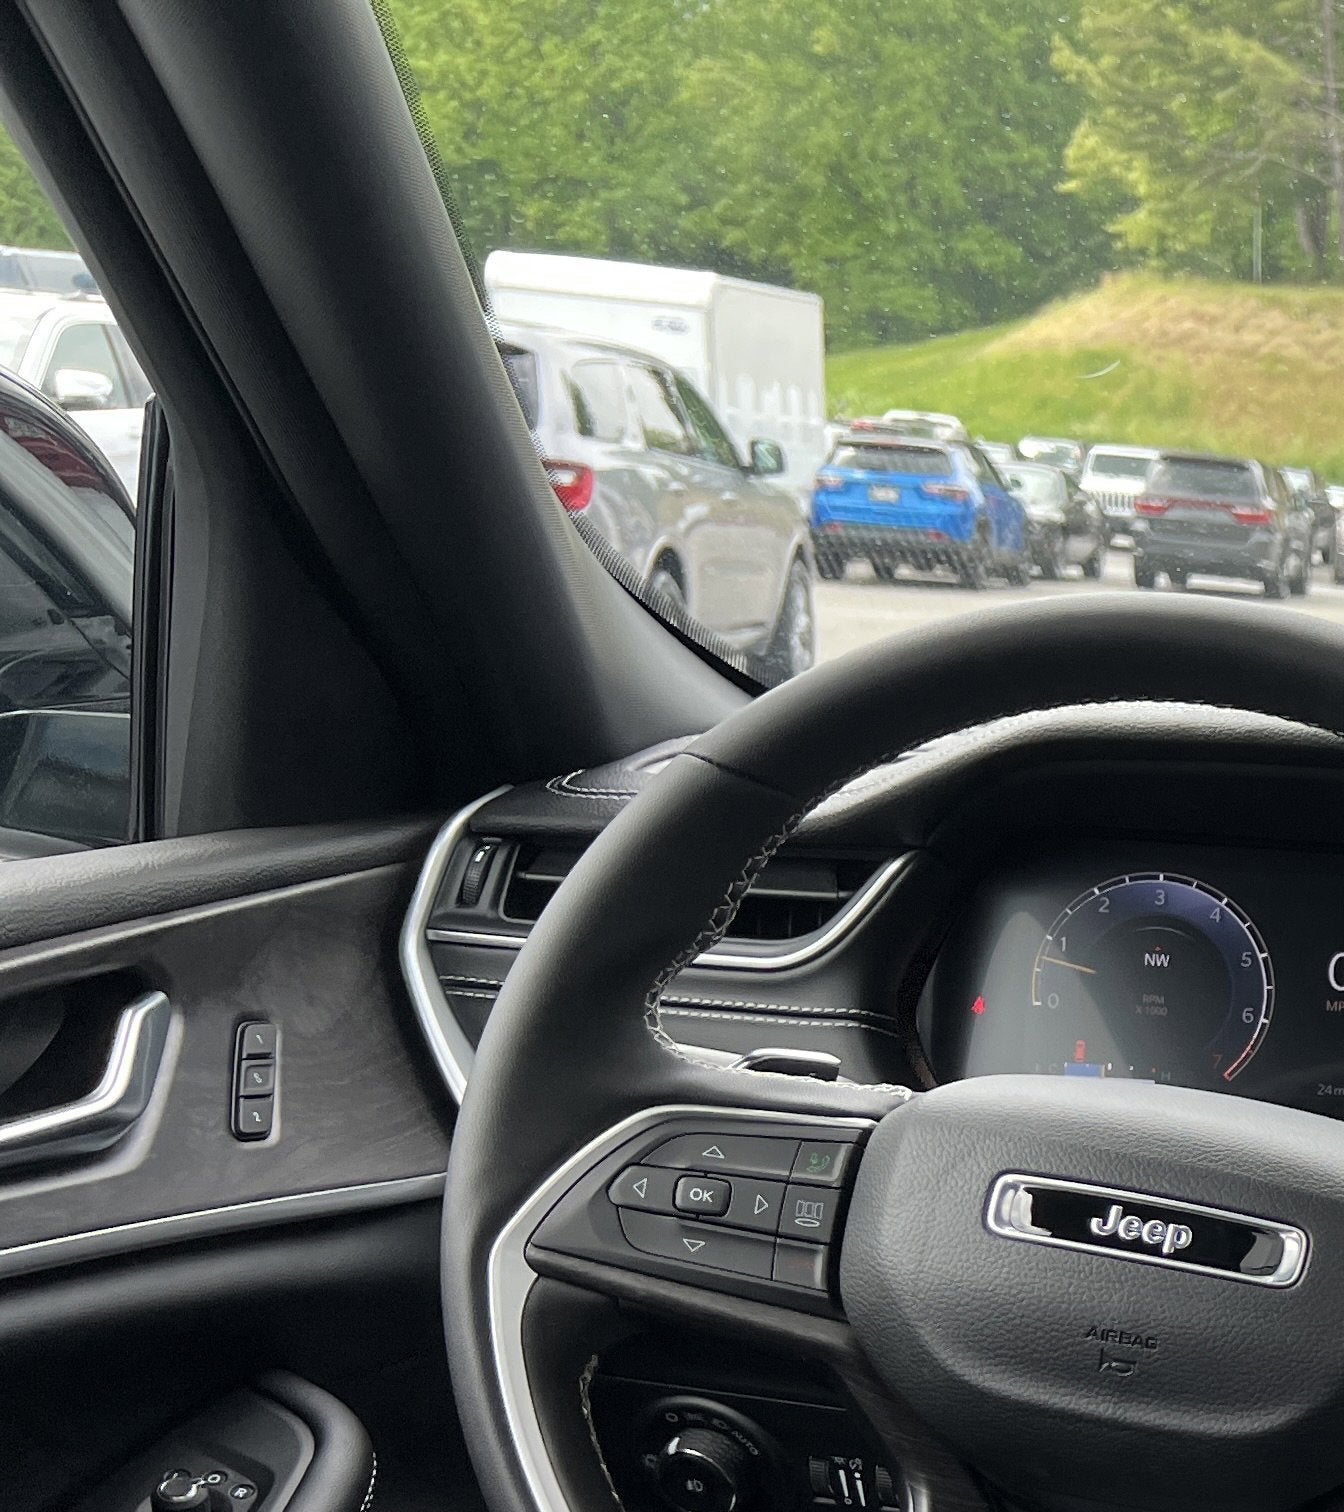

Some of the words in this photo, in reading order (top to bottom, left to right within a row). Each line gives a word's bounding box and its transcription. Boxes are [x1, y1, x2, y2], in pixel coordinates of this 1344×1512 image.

[1154, 889, 1165, 905] 3
[1098, 897, 1110, 913] 2
[1210, 907, 1222, 922] 4
[1060, 937, 1067, 951] 1
[1144, 953, 1170, 967] NW
[1241, 952, 1252, 967] 5
[1048, 993, 1059, 1008] 0
[1242, 1007, 1254, 1023] 6
[1211, 1054, 1223, 1069] 7
[690, 1188, 713, 1203] OK
[1090, 1205, 1192, 1254] Jeep
[1086, 1326, 1158, 1350] AIRBAG
[234, 1487, 248, 1498] R
